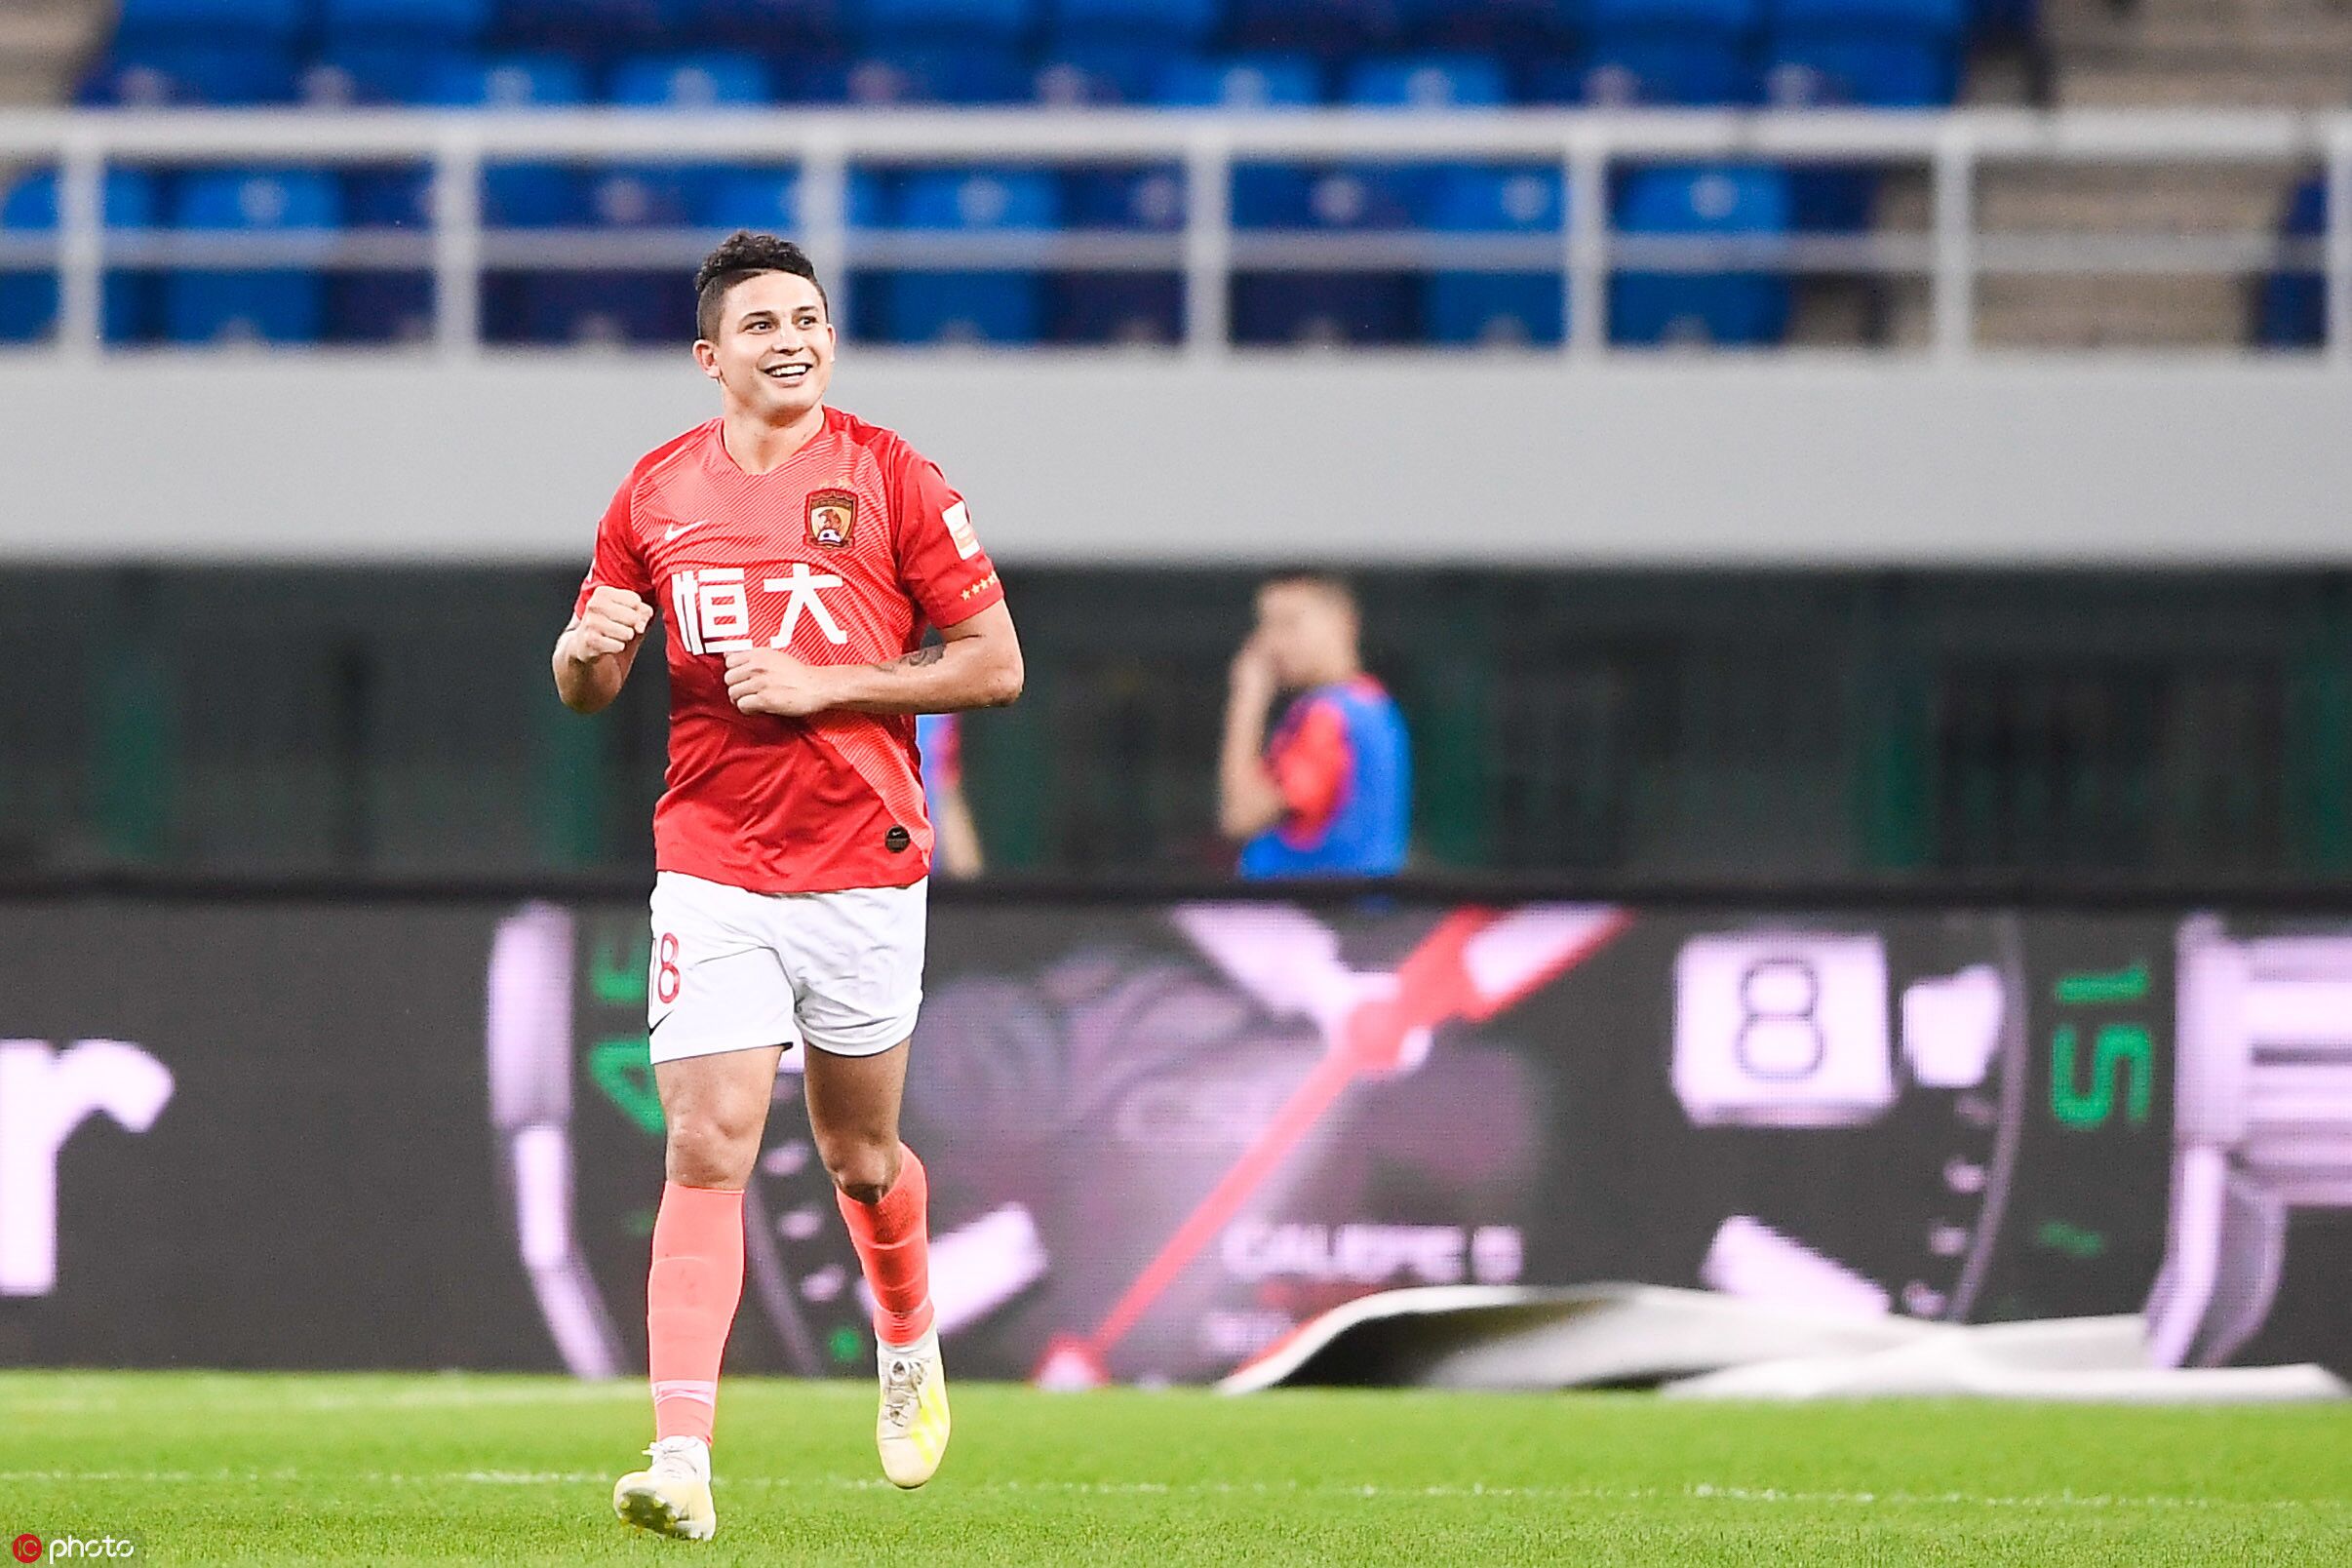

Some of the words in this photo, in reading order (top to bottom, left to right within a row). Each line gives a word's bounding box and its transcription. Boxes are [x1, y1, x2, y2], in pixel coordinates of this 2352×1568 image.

[671, 563, 848, 655] 恒大
[1738, 957, 1825, 1081] 8
[2052, 961, 2153, 1128] 15
